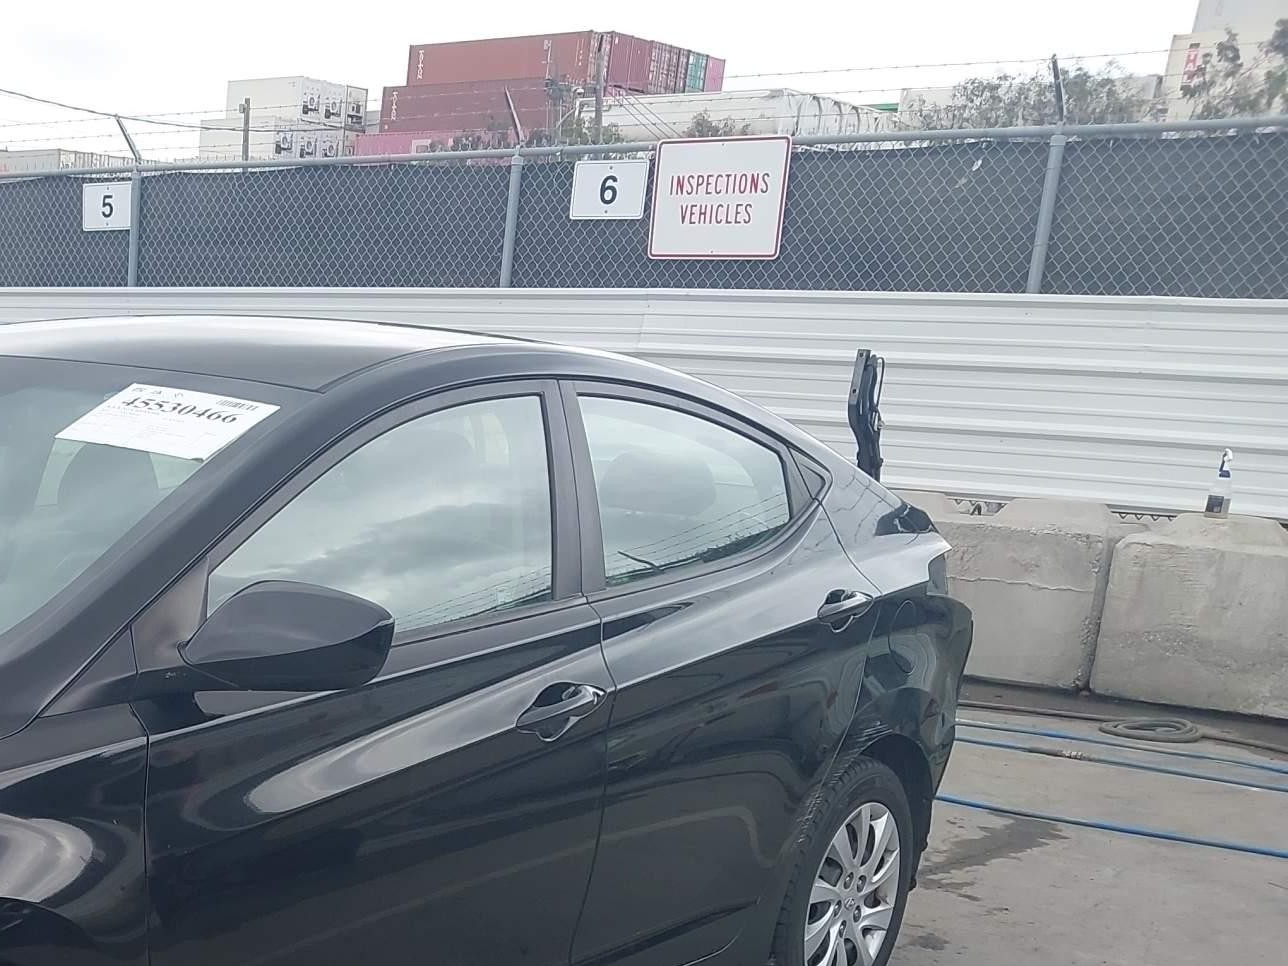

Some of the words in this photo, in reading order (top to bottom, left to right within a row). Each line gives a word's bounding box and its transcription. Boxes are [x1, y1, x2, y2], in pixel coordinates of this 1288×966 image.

[599, 175, 619, 205] 6
[669, 172, 771, 196] INSPECTIONS
[101, 194, 114, 218] 5
[680, 203, 753, 225] VEHICLES
[122, 397, 242, 424] 45530466
